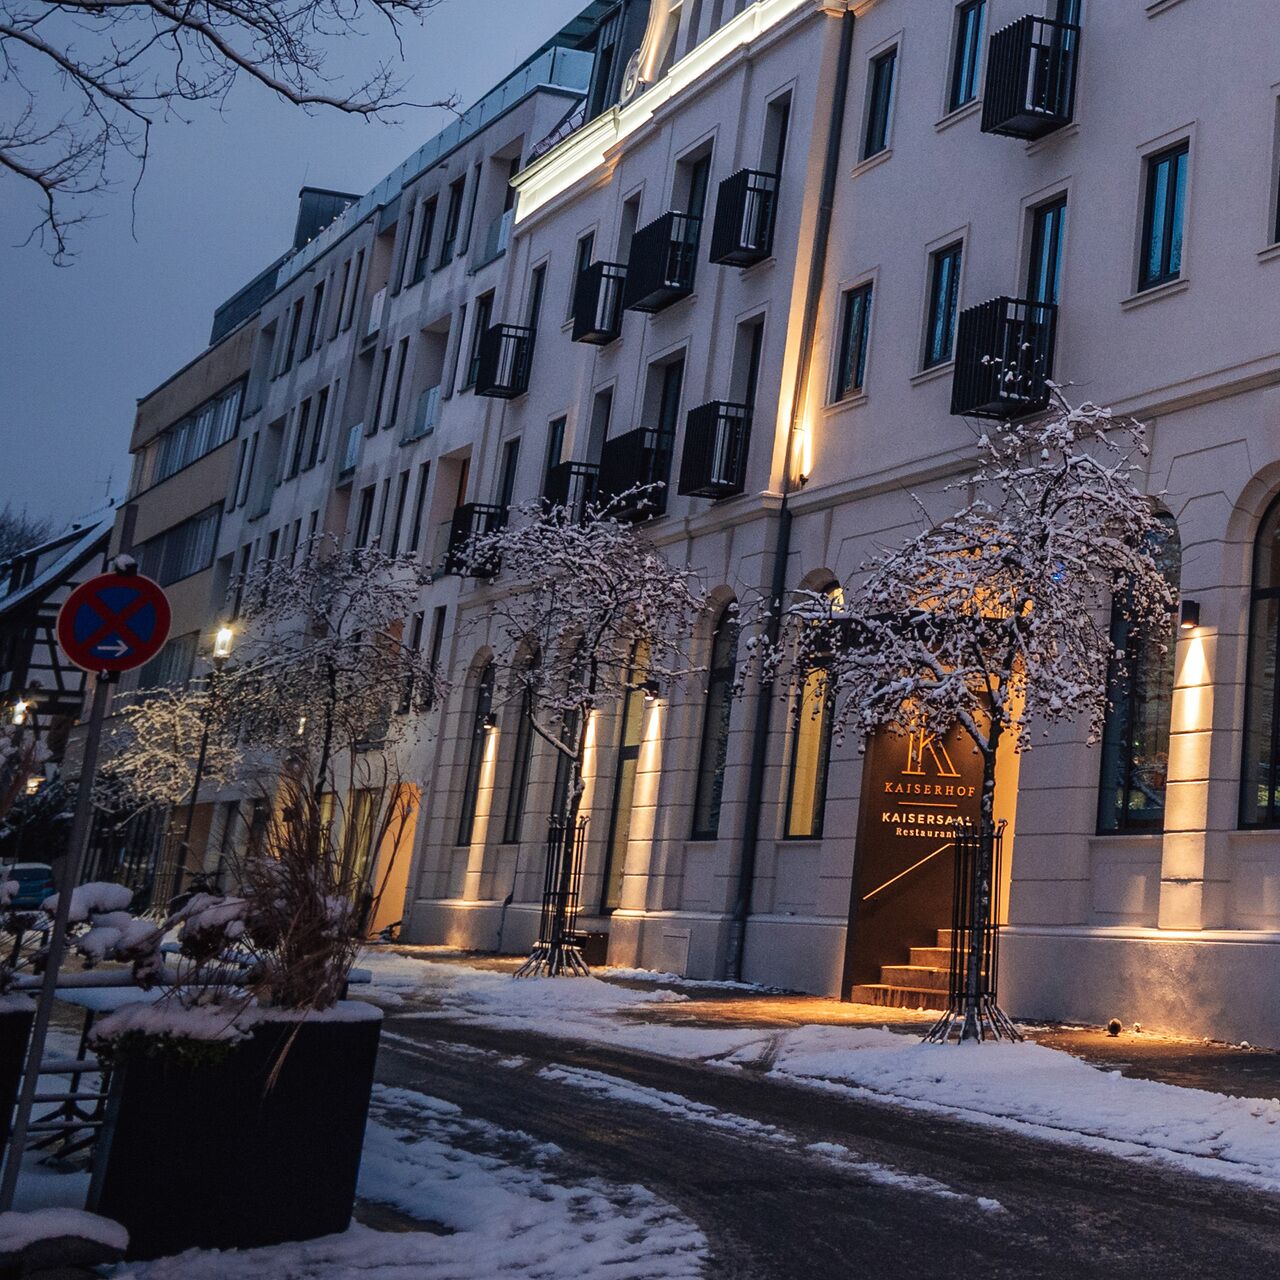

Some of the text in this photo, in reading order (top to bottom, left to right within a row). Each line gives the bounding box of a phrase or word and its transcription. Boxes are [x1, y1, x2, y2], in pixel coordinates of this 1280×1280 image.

[901, 709, 961, 777] K
[884, 782, 976, 797] KAISERHOF
[882, 812, 972, 826] KAISERSAAL
[896, 827, 957, 838] Restaurant
